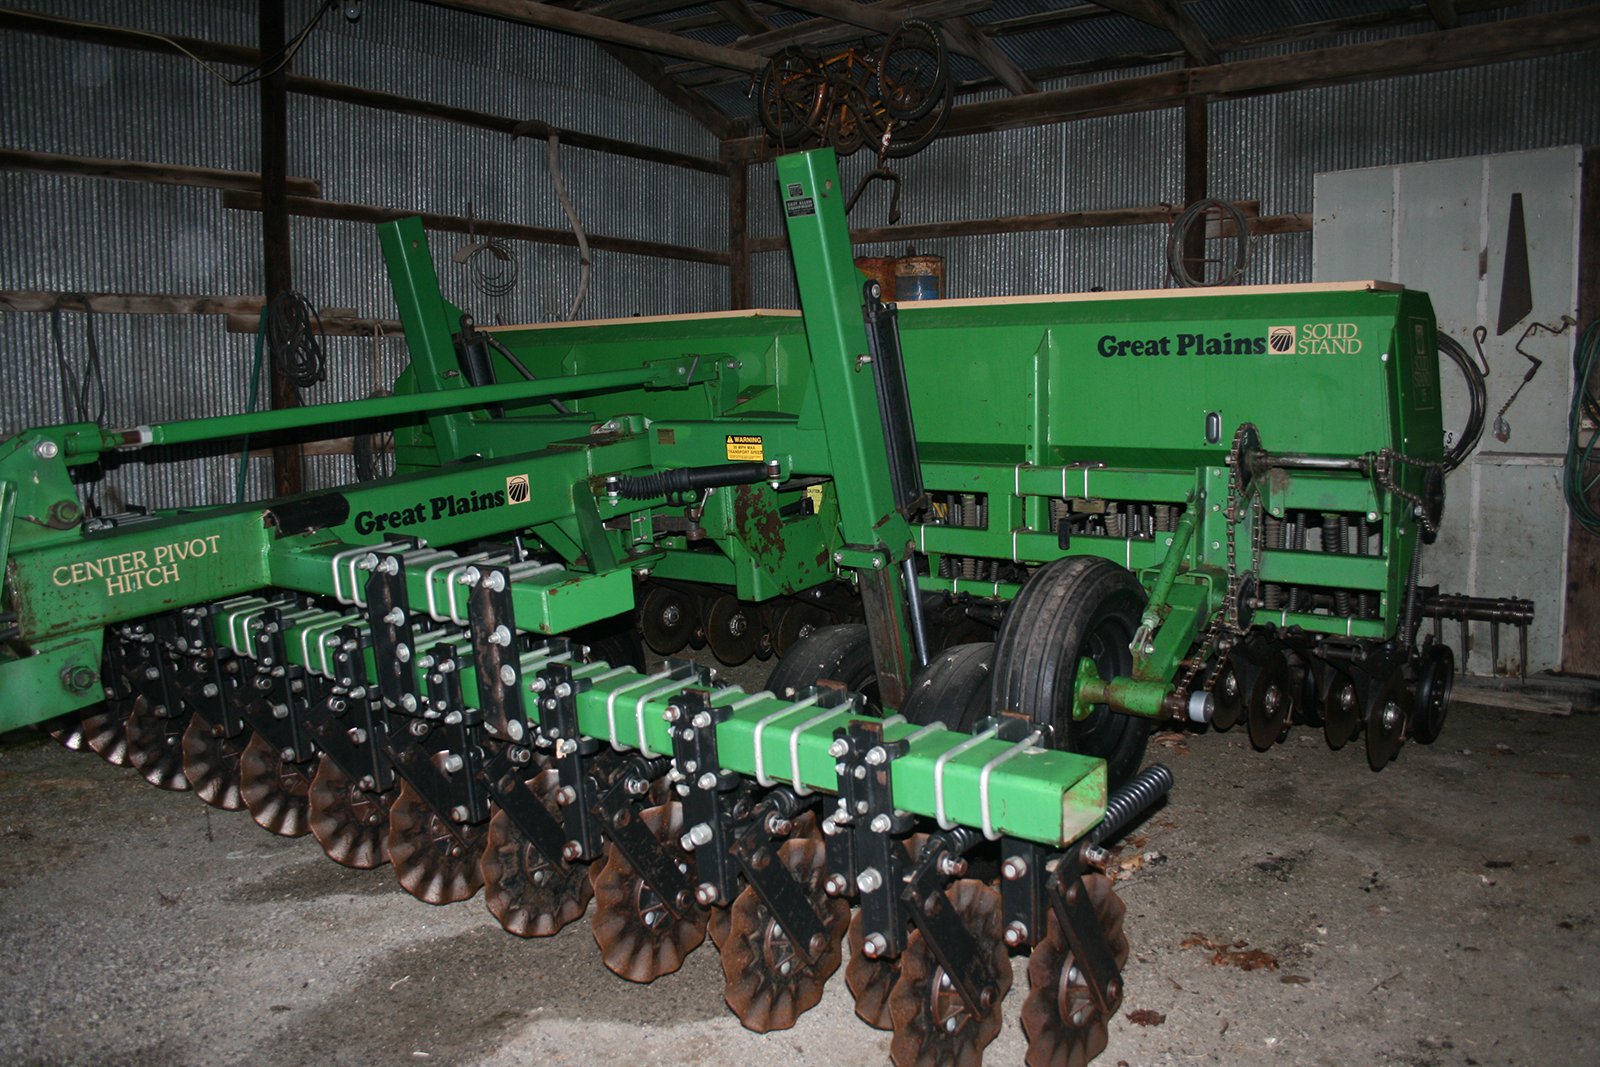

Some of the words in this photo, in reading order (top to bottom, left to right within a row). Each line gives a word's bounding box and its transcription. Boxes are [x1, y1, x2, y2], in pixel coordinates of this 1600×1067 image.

[1302, 323, 1358, 340] SOLID
[1097, 335, 1171, 358] Great
[1176, 332, 1266, 356] Plains
[1298, 339, 1362, 355] STAND
[733, 436, 762, 444] WARNING
[355, 502, 427, 535] Great
[429, 490, 505, 520] Plains
[53, 550, 149, 586] CENTER
[153, 535, 220, 566] PIVOT
[105, 563, 180, 596] HITCH
